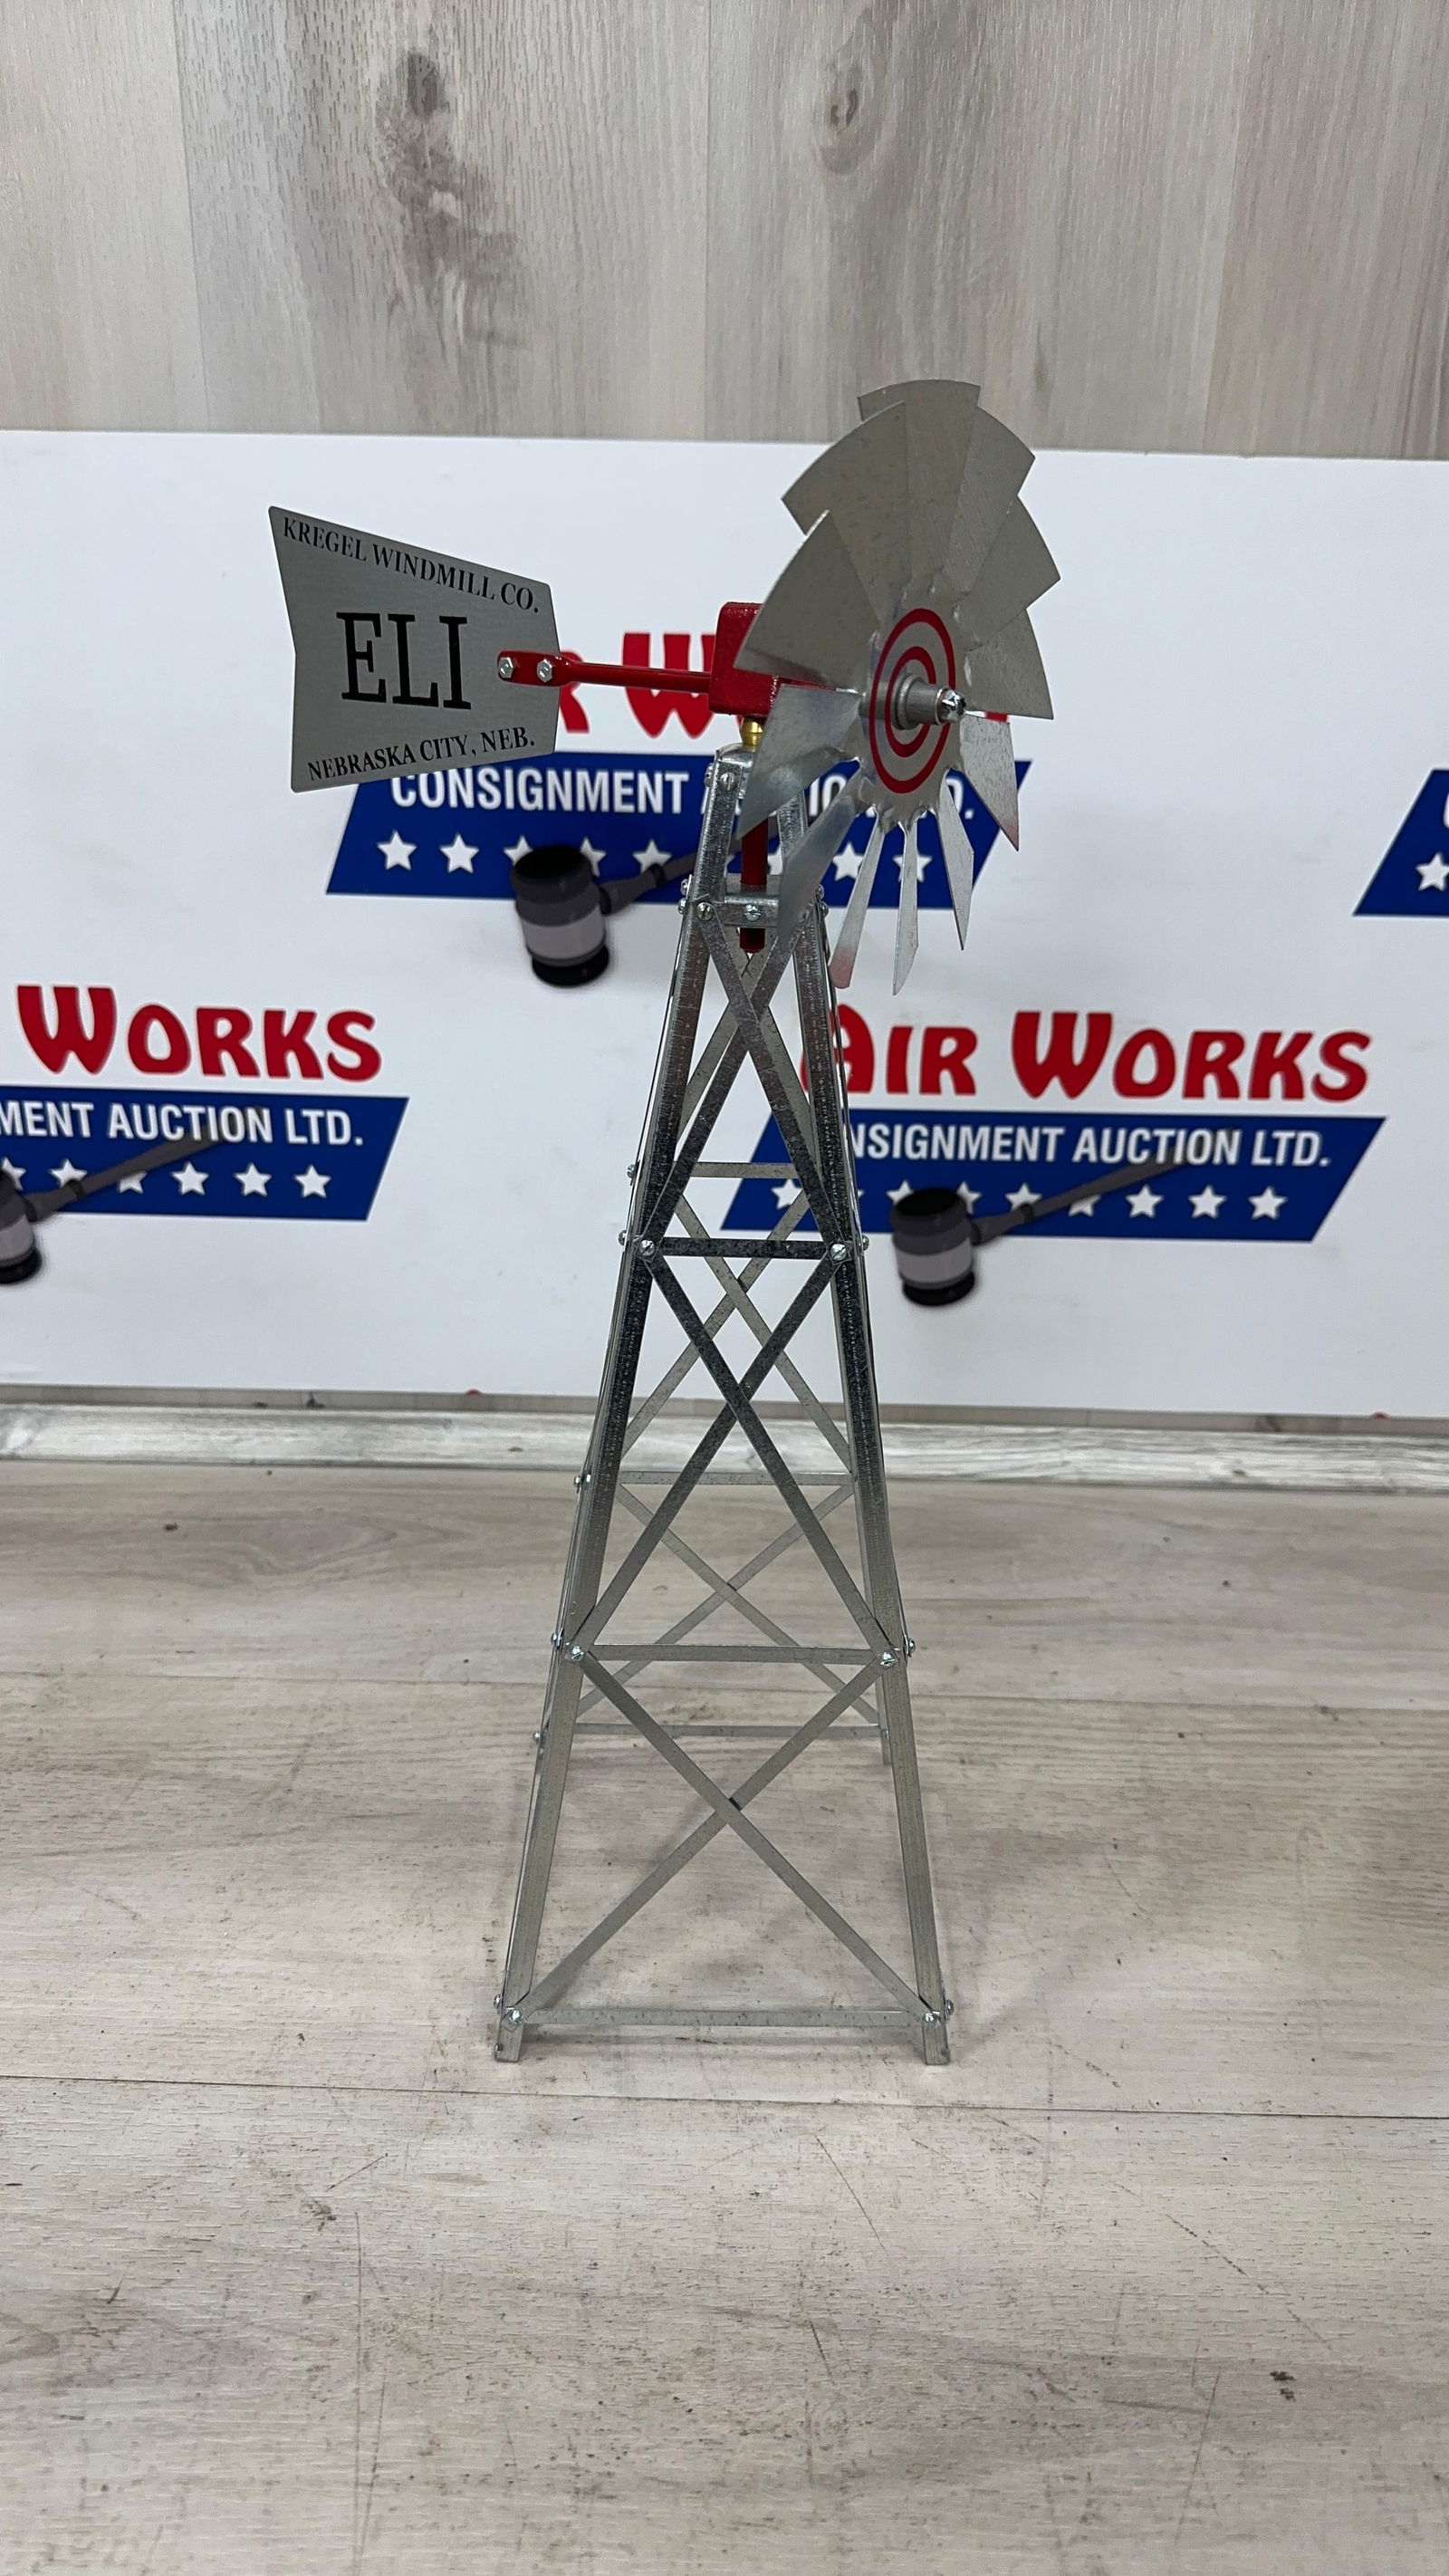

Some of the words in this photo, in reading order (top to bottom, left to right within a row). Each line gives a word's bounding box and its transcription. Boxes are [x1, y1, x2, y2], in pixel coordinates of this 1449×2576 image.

[283, 517, 367, 562] KREGEL
[372, 543, 495, 600] WINDMILL
[500, 582, 539, 613] CO.
[336, 611, 472, 710] ELI
[308, 743, 417, 781] NEBRASKA
[419, 735, 476, 761] CITY,
[481, 726, 534, 753] NEB.
[390, 767, 690, 814] CONSIGNMENT
[16, 985, 382, 1081] WORKS
[1011, 1011, 1370, 1101] WORKS
[108, 1102, 273, 1143] AUCTION
[286, 1108, 364, 1146] LTD.
[849, 1121, 1066, 1163] NSIGNMENT
[1071, 1127, 1243, 1167] AUCTION
[1251, 1130, 1332, 1168] LTD.
